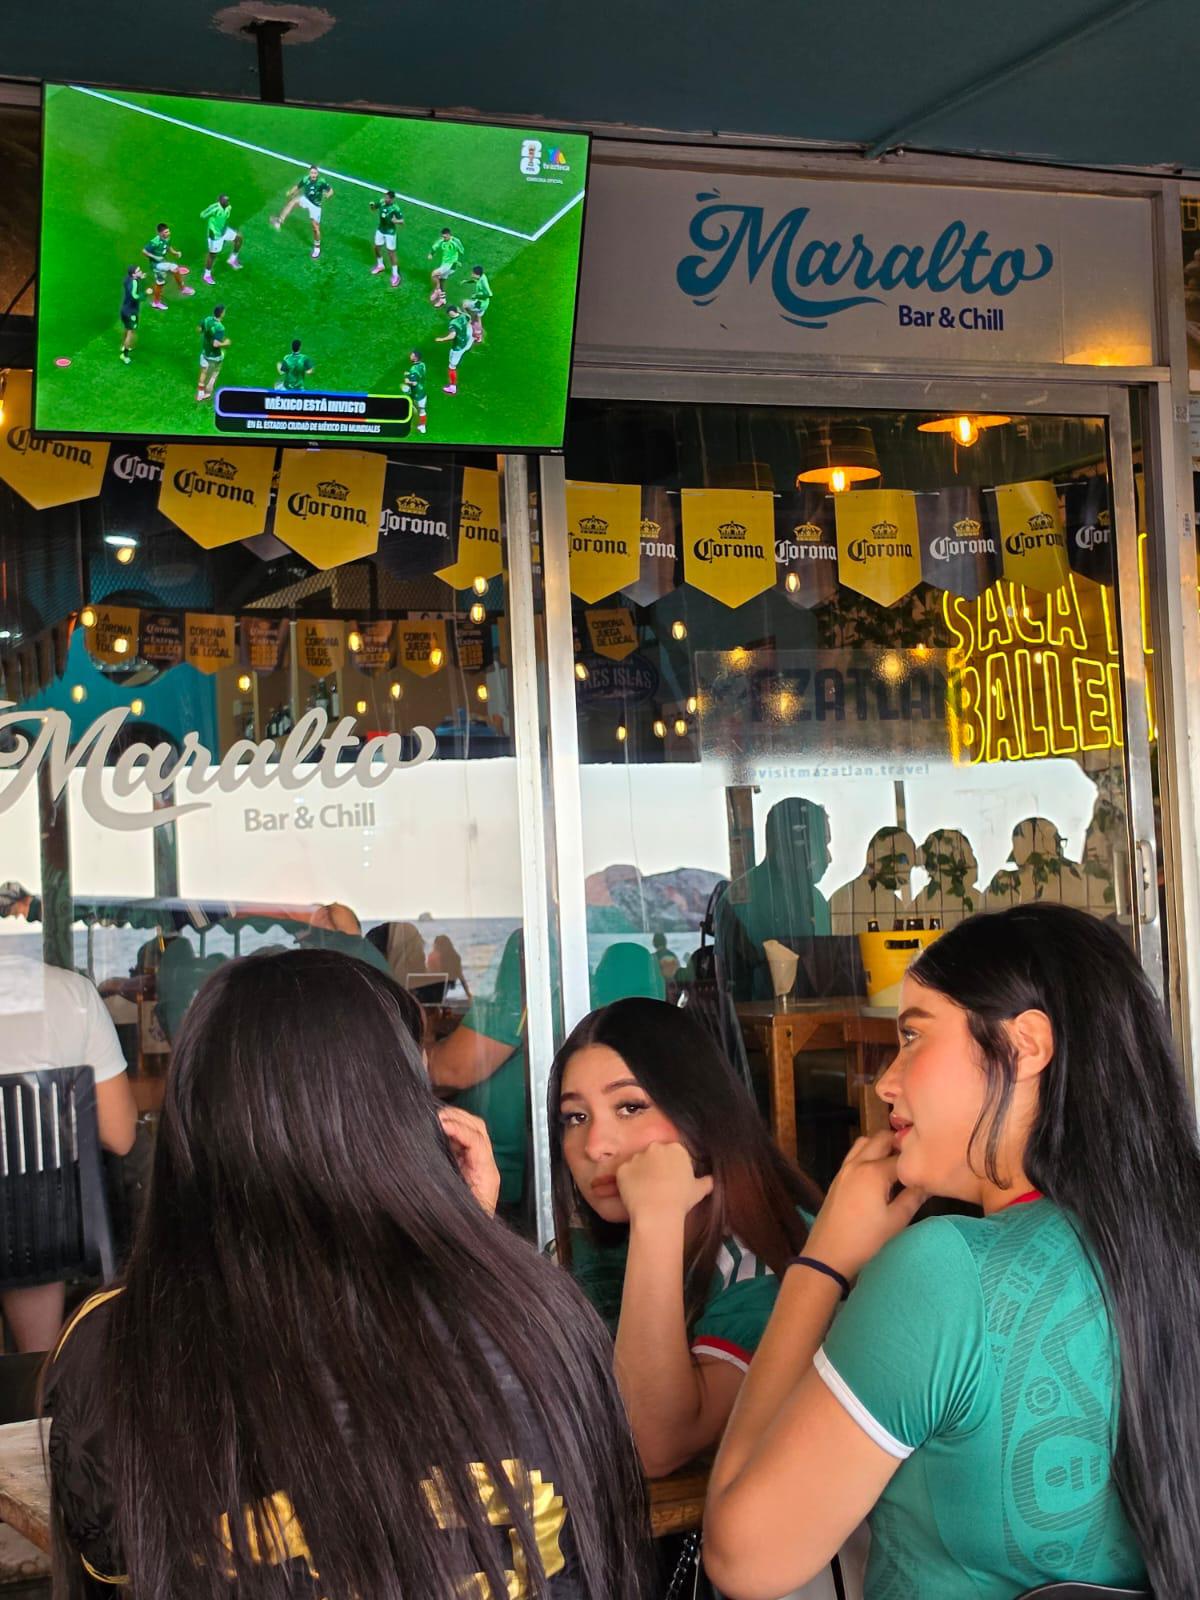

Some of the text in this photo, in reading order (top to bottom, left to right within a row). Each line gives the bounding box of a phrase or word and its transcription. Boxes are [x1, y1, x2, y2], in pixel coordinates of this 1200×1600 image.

[676, 204, 1053, 318] Maralto
[899, 305, 1004, 331] Bar & Chill
[265, 396, 366, 414] MÉXICO ESTÁ INVICTO
[264, 421, 287, 430] ESTADIO
[288, 421, 309, 431] CIUDAD
[113, 454, 163, 483] Cor
[174, 468, 255, 504] Corona
[288, 492, 367, 524] Corona
[694, 537, 764, 563] Corona
[774, 539, 837, 565] Corona
[848, 538, 913, 564] Corona
[929, 536, 995, 562] Corona
[190, 626, 226, 637] CORONA
[203, 647, 231, 658] LOCAL
[948, 649, 1123, 765] BALLE
[0, 706, 436, 832] Maralto
[245, 802, 376, 832] Bar & Chill
